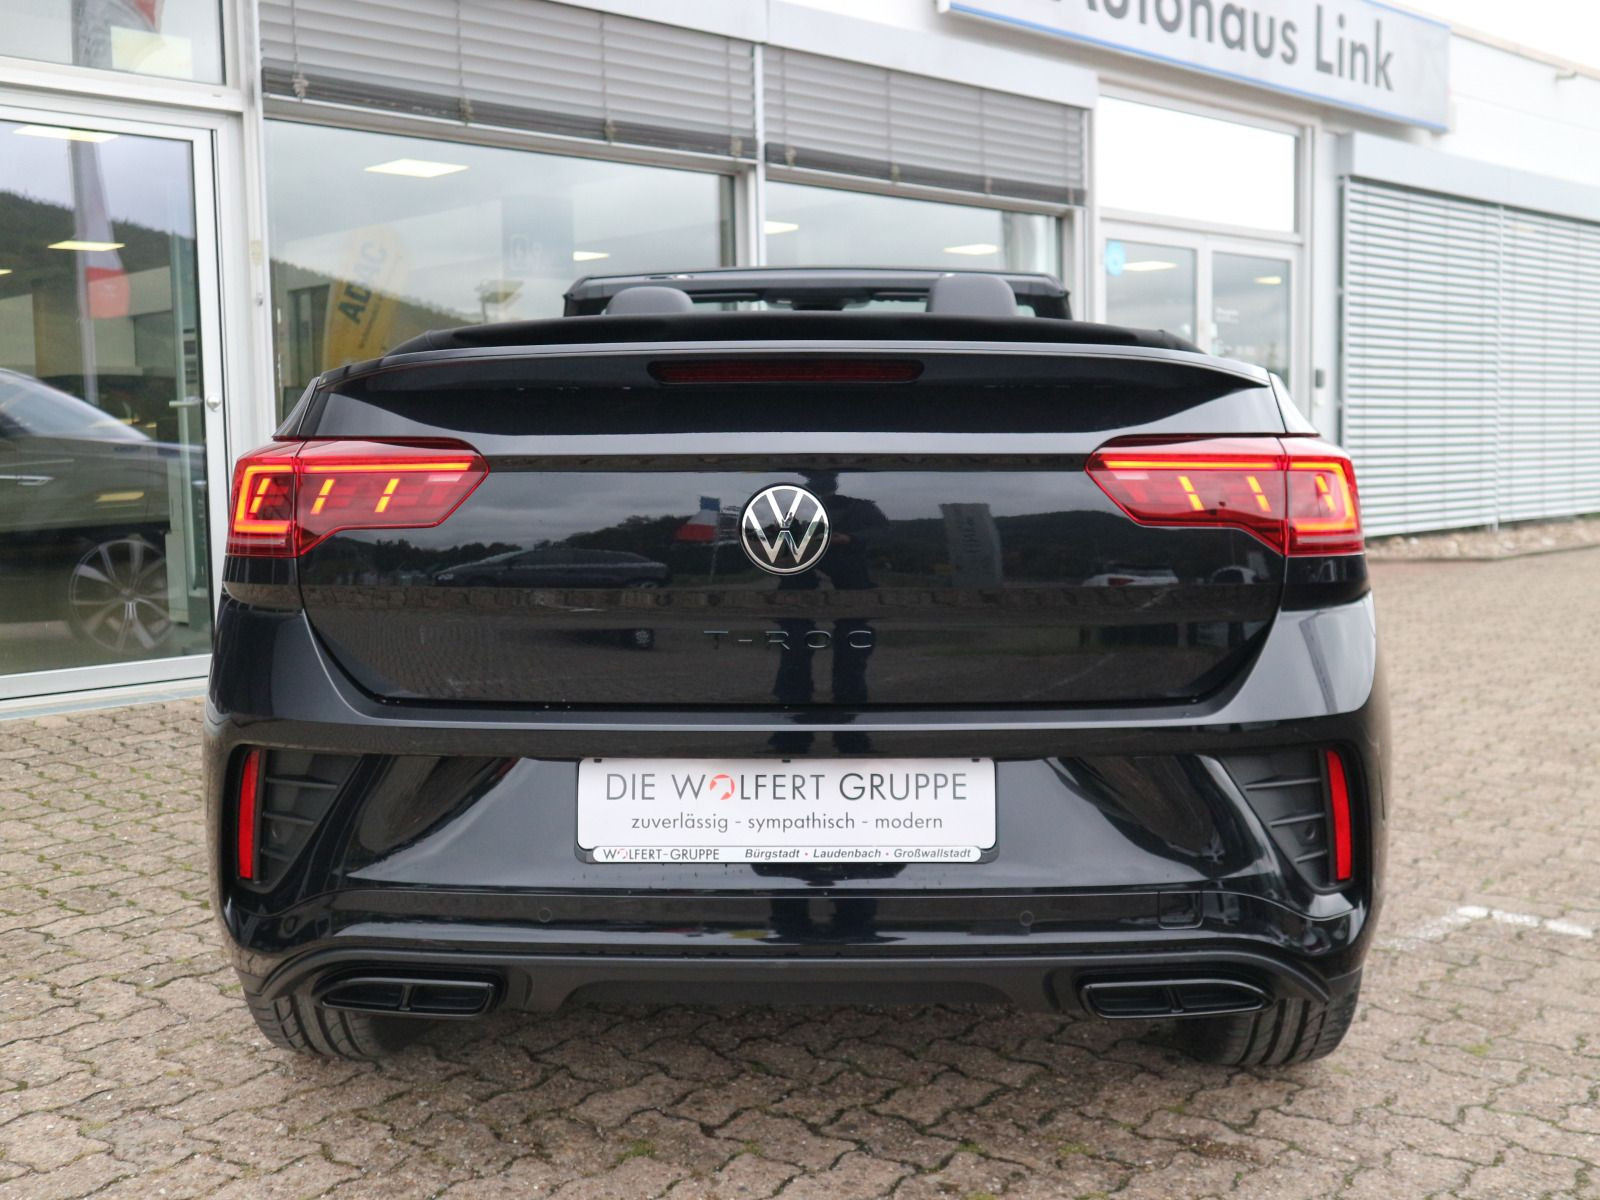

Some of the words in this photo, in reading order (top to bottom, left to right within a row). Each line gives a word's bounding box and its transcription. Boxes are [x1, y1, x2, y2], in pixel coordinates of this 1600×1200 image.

[1054, 0, 1298, 66] ohaus
[1315, 4, 1394, 92] Link
[703, 630, 873, 650] T-ROC
[606, 773, 656, 801] DIE
[671, 773, 826, 801] WOLFERT
[839, 772, 967, 801] GRUPPE
[631, 811, 729, 833] zuverlässig
[747, 811, 855, 833] sympathisch
[875, 811, 943, 829] modern
[744, 847, 800, 860] Bürgstadt
[813, 847, 882, 859] Laudenbach
[893, 847, 971, 859] Großwallstadt
